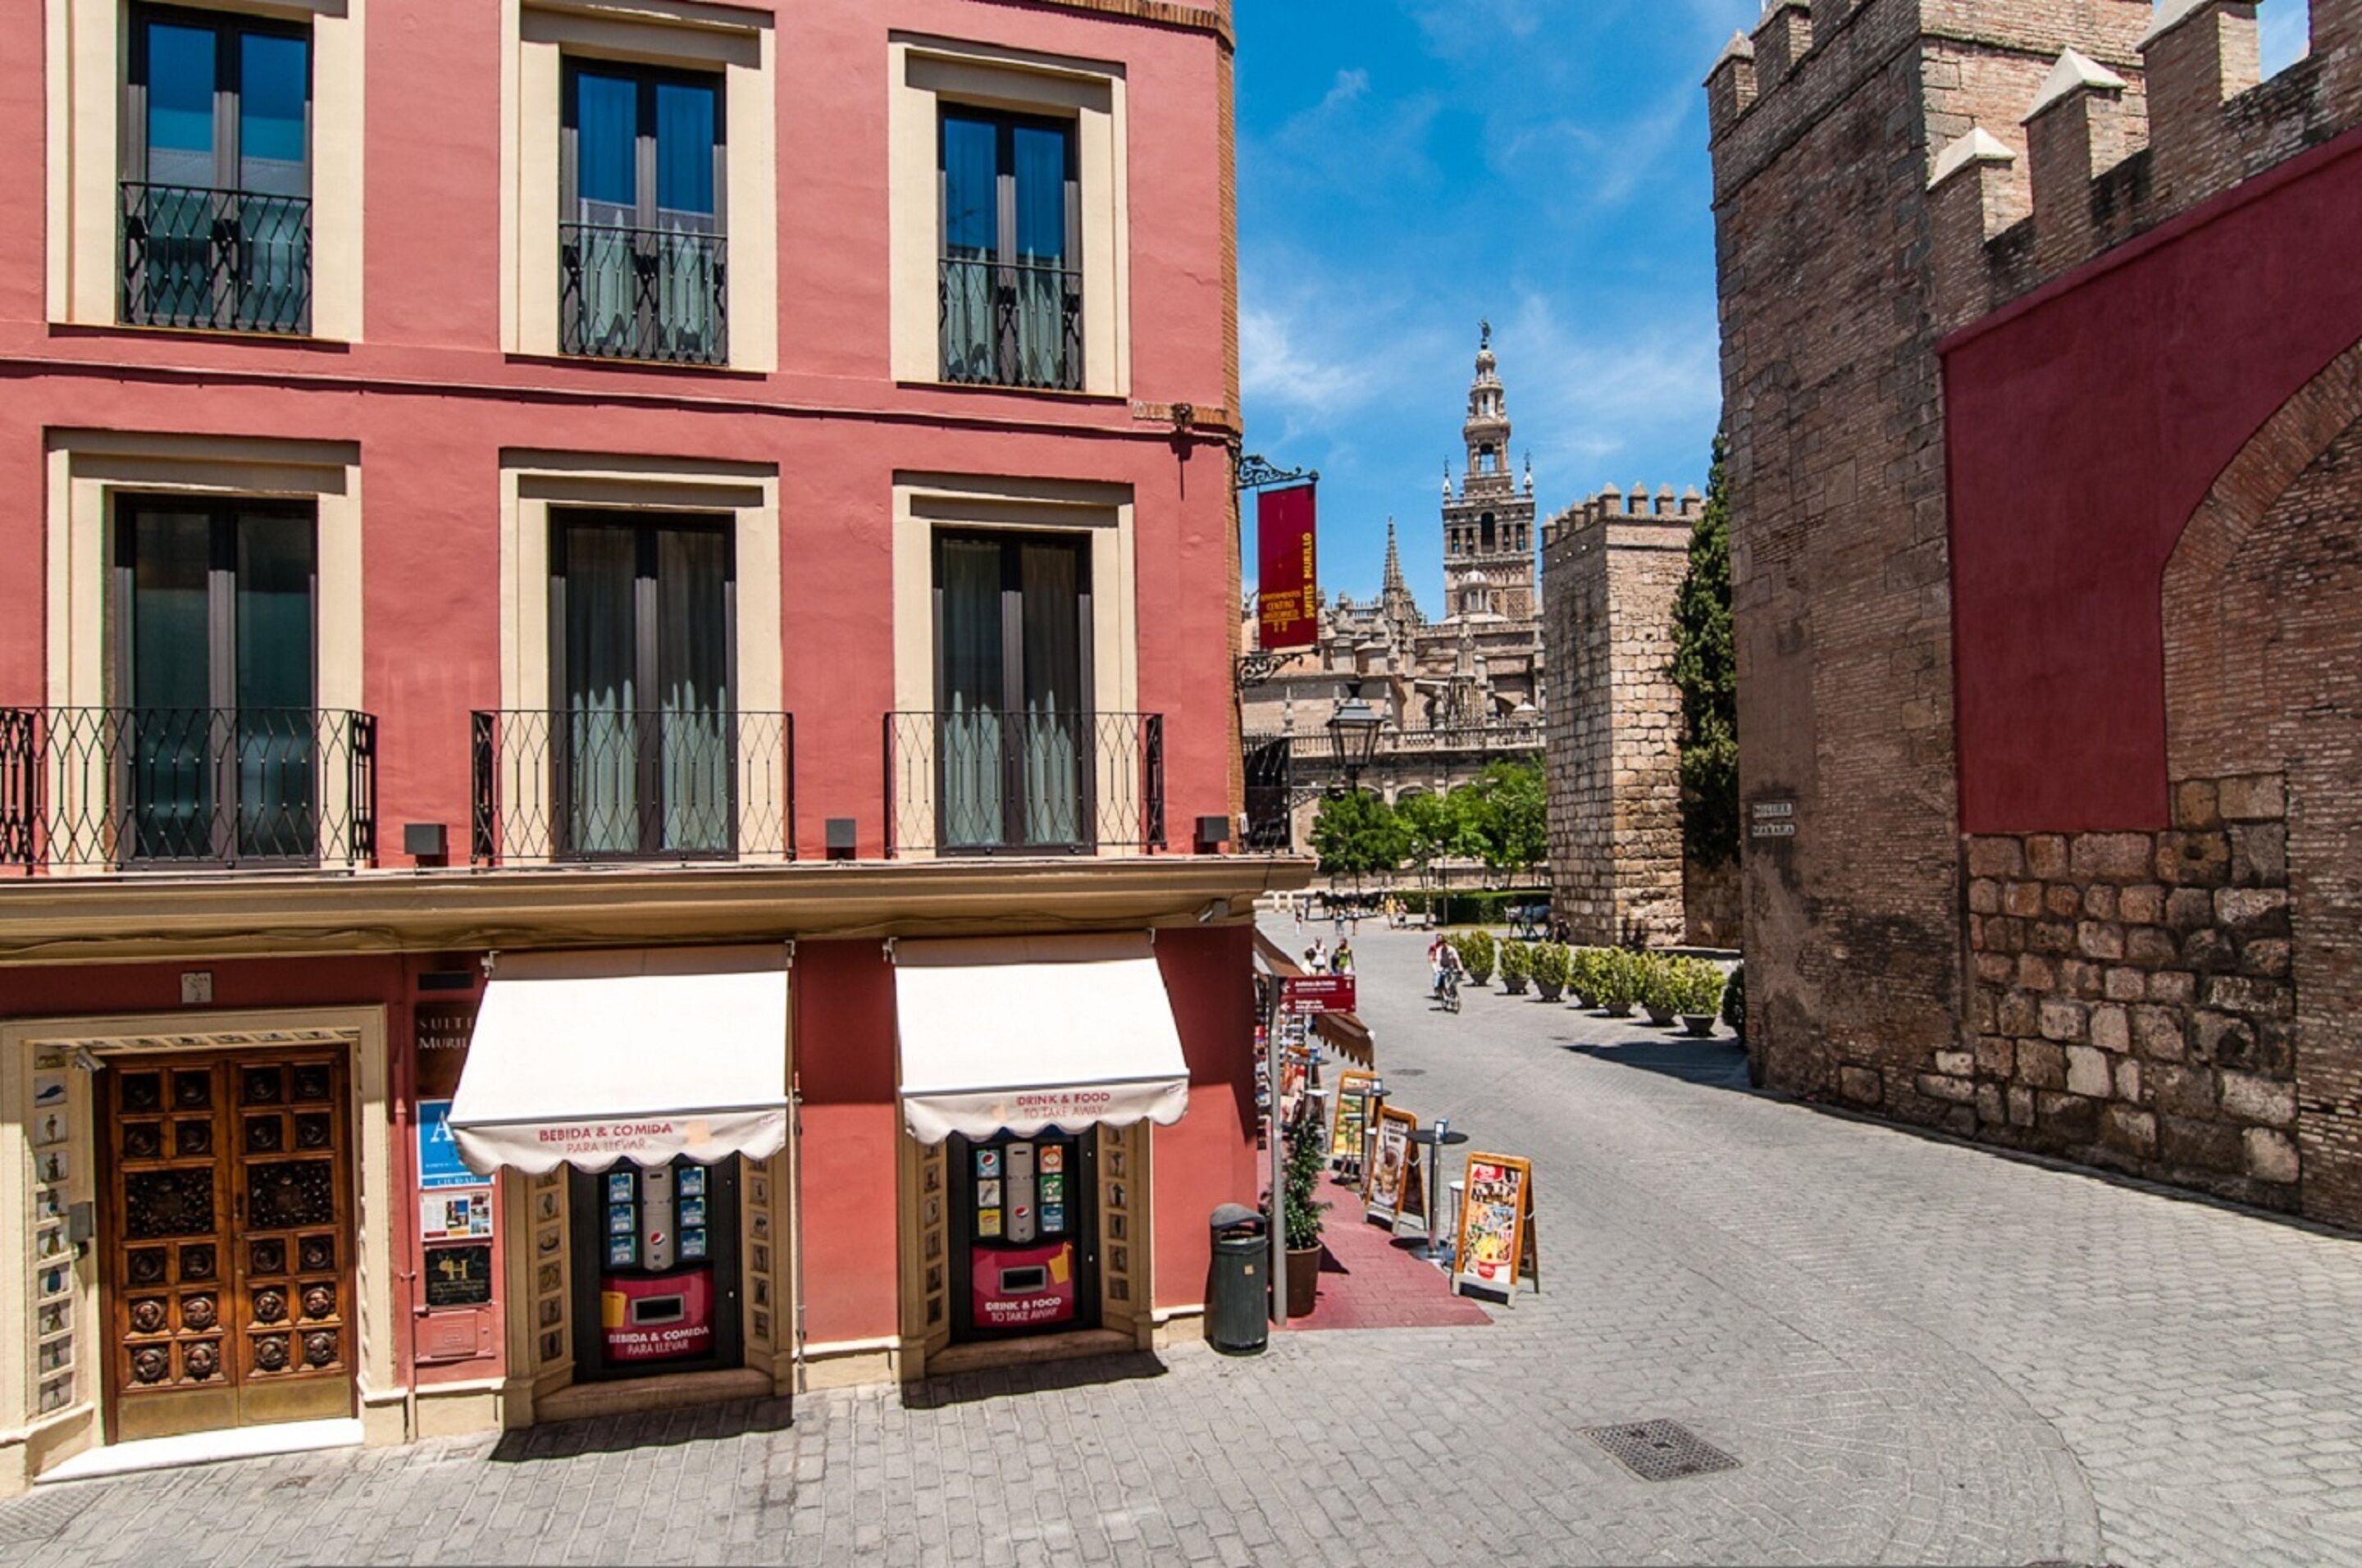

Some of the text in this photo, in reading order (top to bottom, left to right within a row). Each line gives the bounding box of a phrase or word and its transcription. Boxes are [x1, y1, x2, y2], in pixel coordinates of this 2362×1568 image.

[1302, 532, 1312, 579] MURILLO
[419, 1017, 473, 1030] SUITE
[1017, 1092, 1110, 1106] DRINK & FOOD
[1024, 1104, 1103, 1119] TO TAKE AWAY
[540, 1123, 673, 1142] BEBIDA & COMIDA
[567, 1137, 646, 1153] PARA LLEVAR
[985, 1297, 1062, 1311] DRINK & FOOD
[992, 1307, 1058, 1322] TO TAKE AWAY
[609, 1326, 709, 1343] BEBIDA & COMIDA
[628, 1338, 689, 1355] PARA LLEVAR
